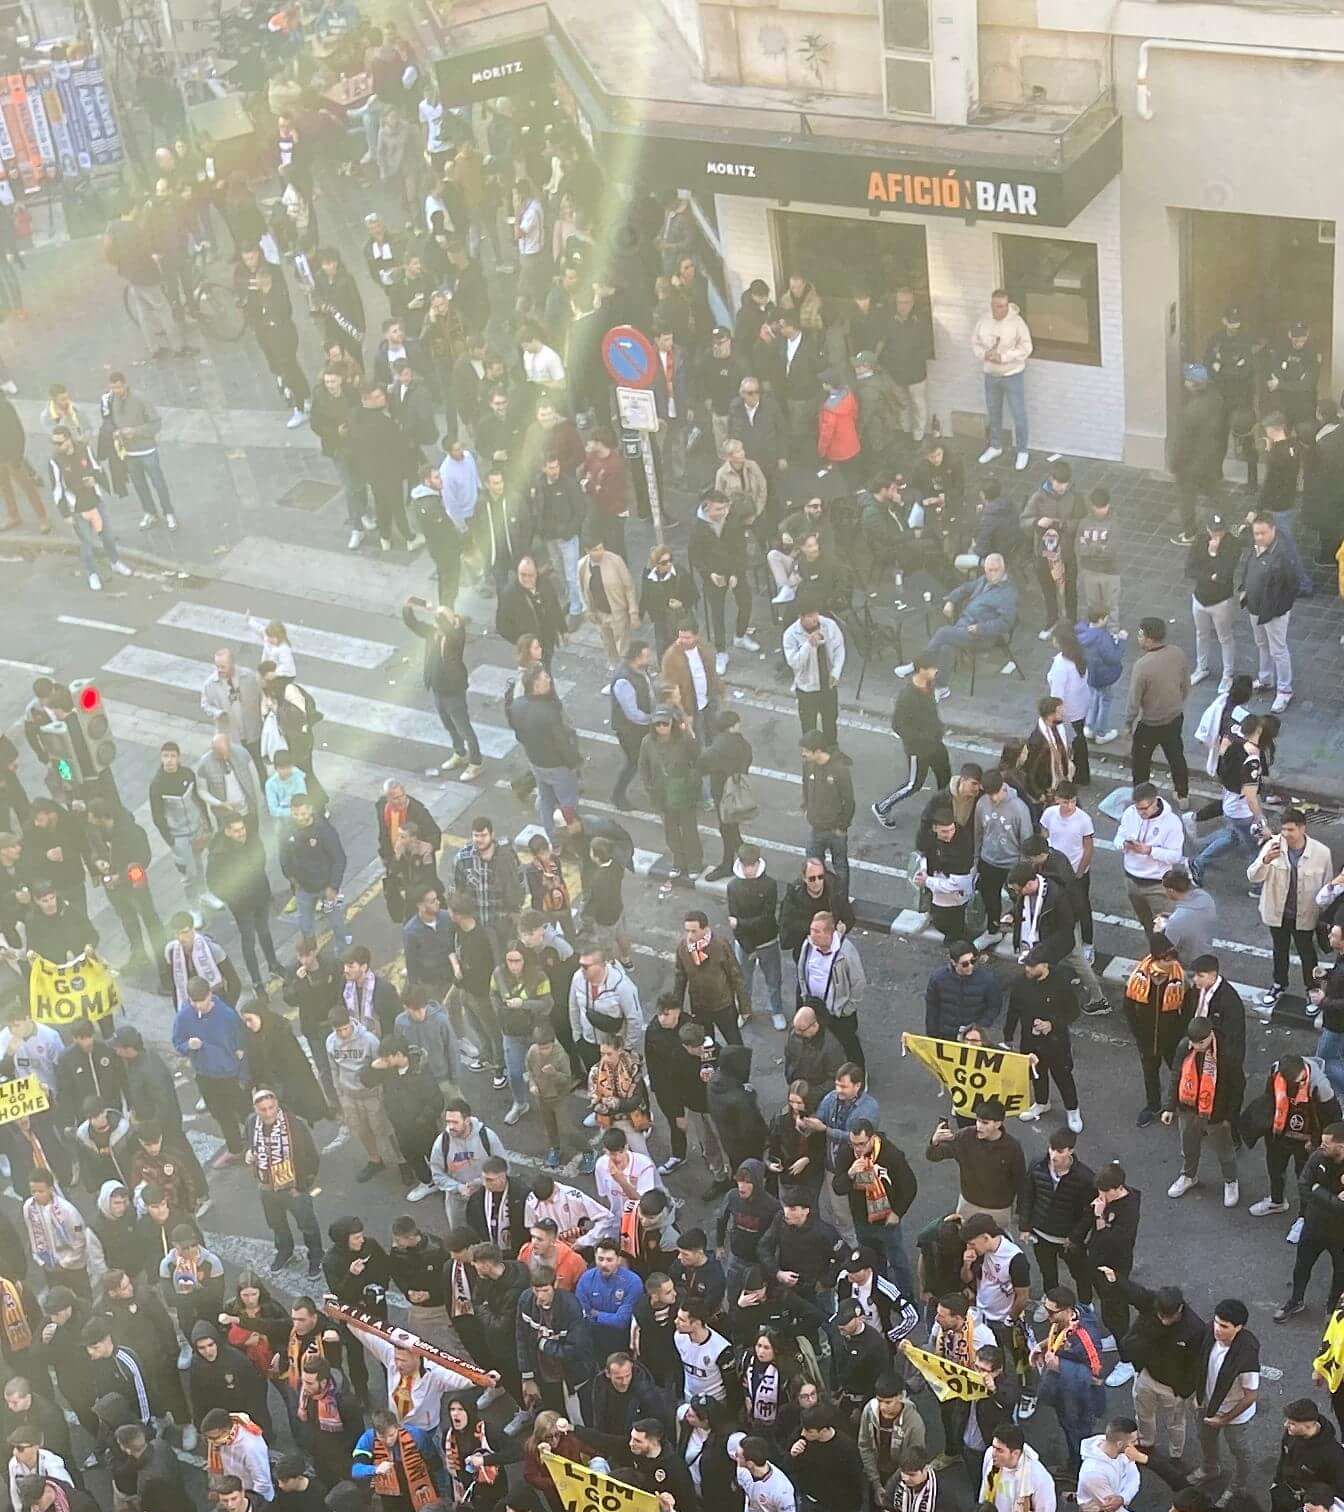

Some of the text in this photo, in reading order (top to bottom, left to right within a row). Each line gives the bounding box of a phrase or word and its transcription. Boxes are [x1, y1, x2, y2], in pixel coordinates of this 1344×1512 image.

[471, 61, 524, 84] MORITZ
[706, 161, 757, 178] MORITZ
[976, 180, 1038, 216] BAR
[54, 977, 86, 996] GO
[936, 1041, 1003, 1074] LIM
[0, 1079, 29, 1099] LIM
[953, 1066, 987, 1089] GO
[8, 1092, 26, 1104] GO
[585, 1485, 622, 1512] GO
